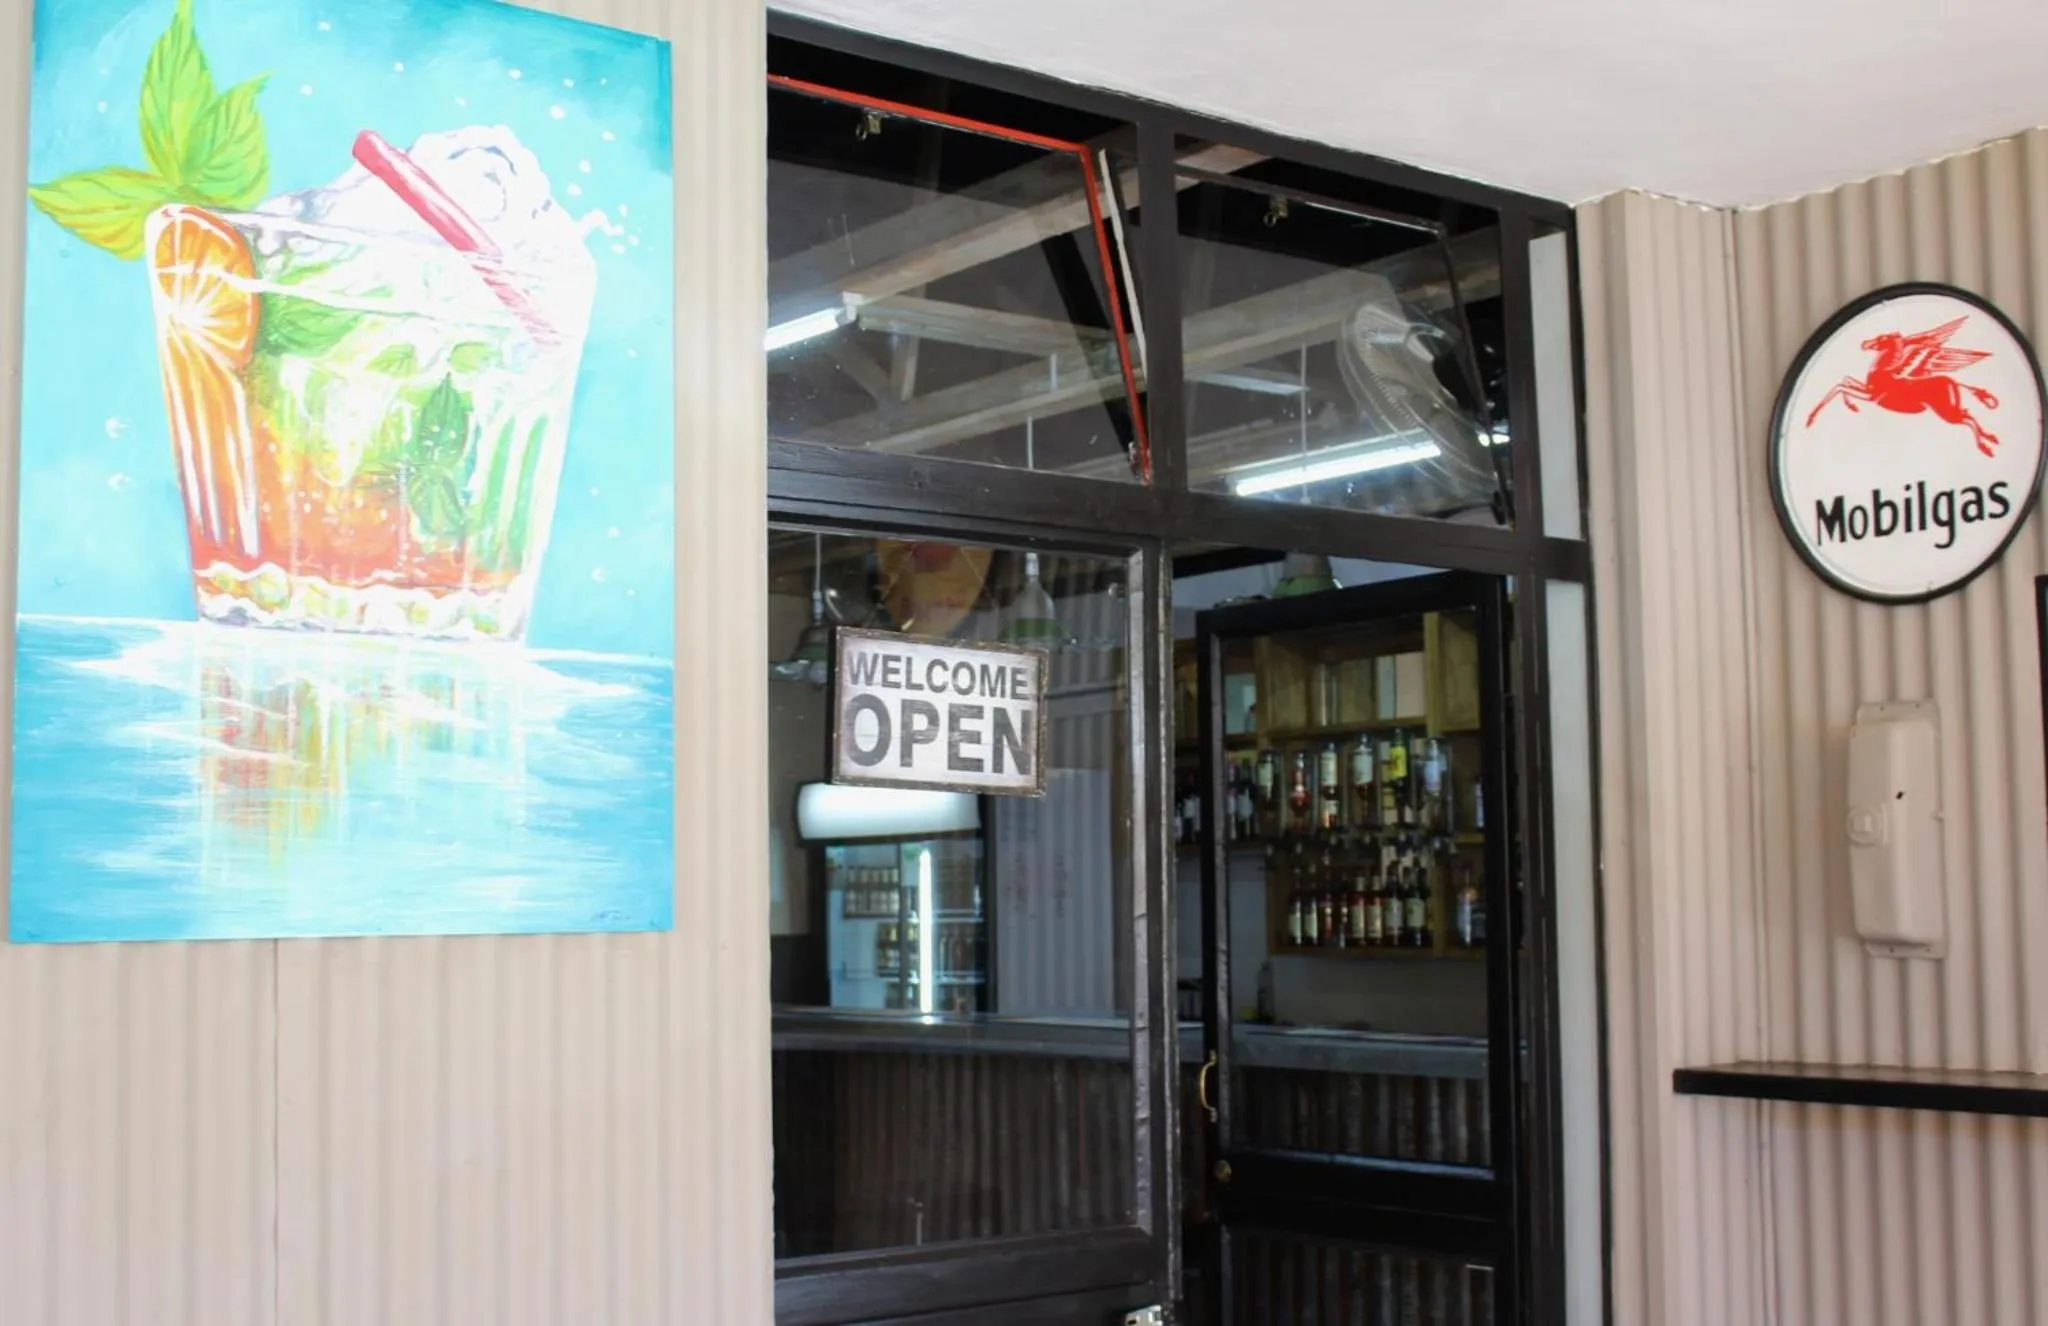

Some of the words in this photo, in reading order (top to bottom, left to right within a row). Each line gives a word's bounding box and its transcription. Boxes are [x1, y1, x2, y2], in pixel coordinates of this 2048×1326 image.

[1815, 480, 2010, 549] Mobilgas
[848, 651, 1030, 700] WELCOME
[845, 693, 1033, 775] OPEN
